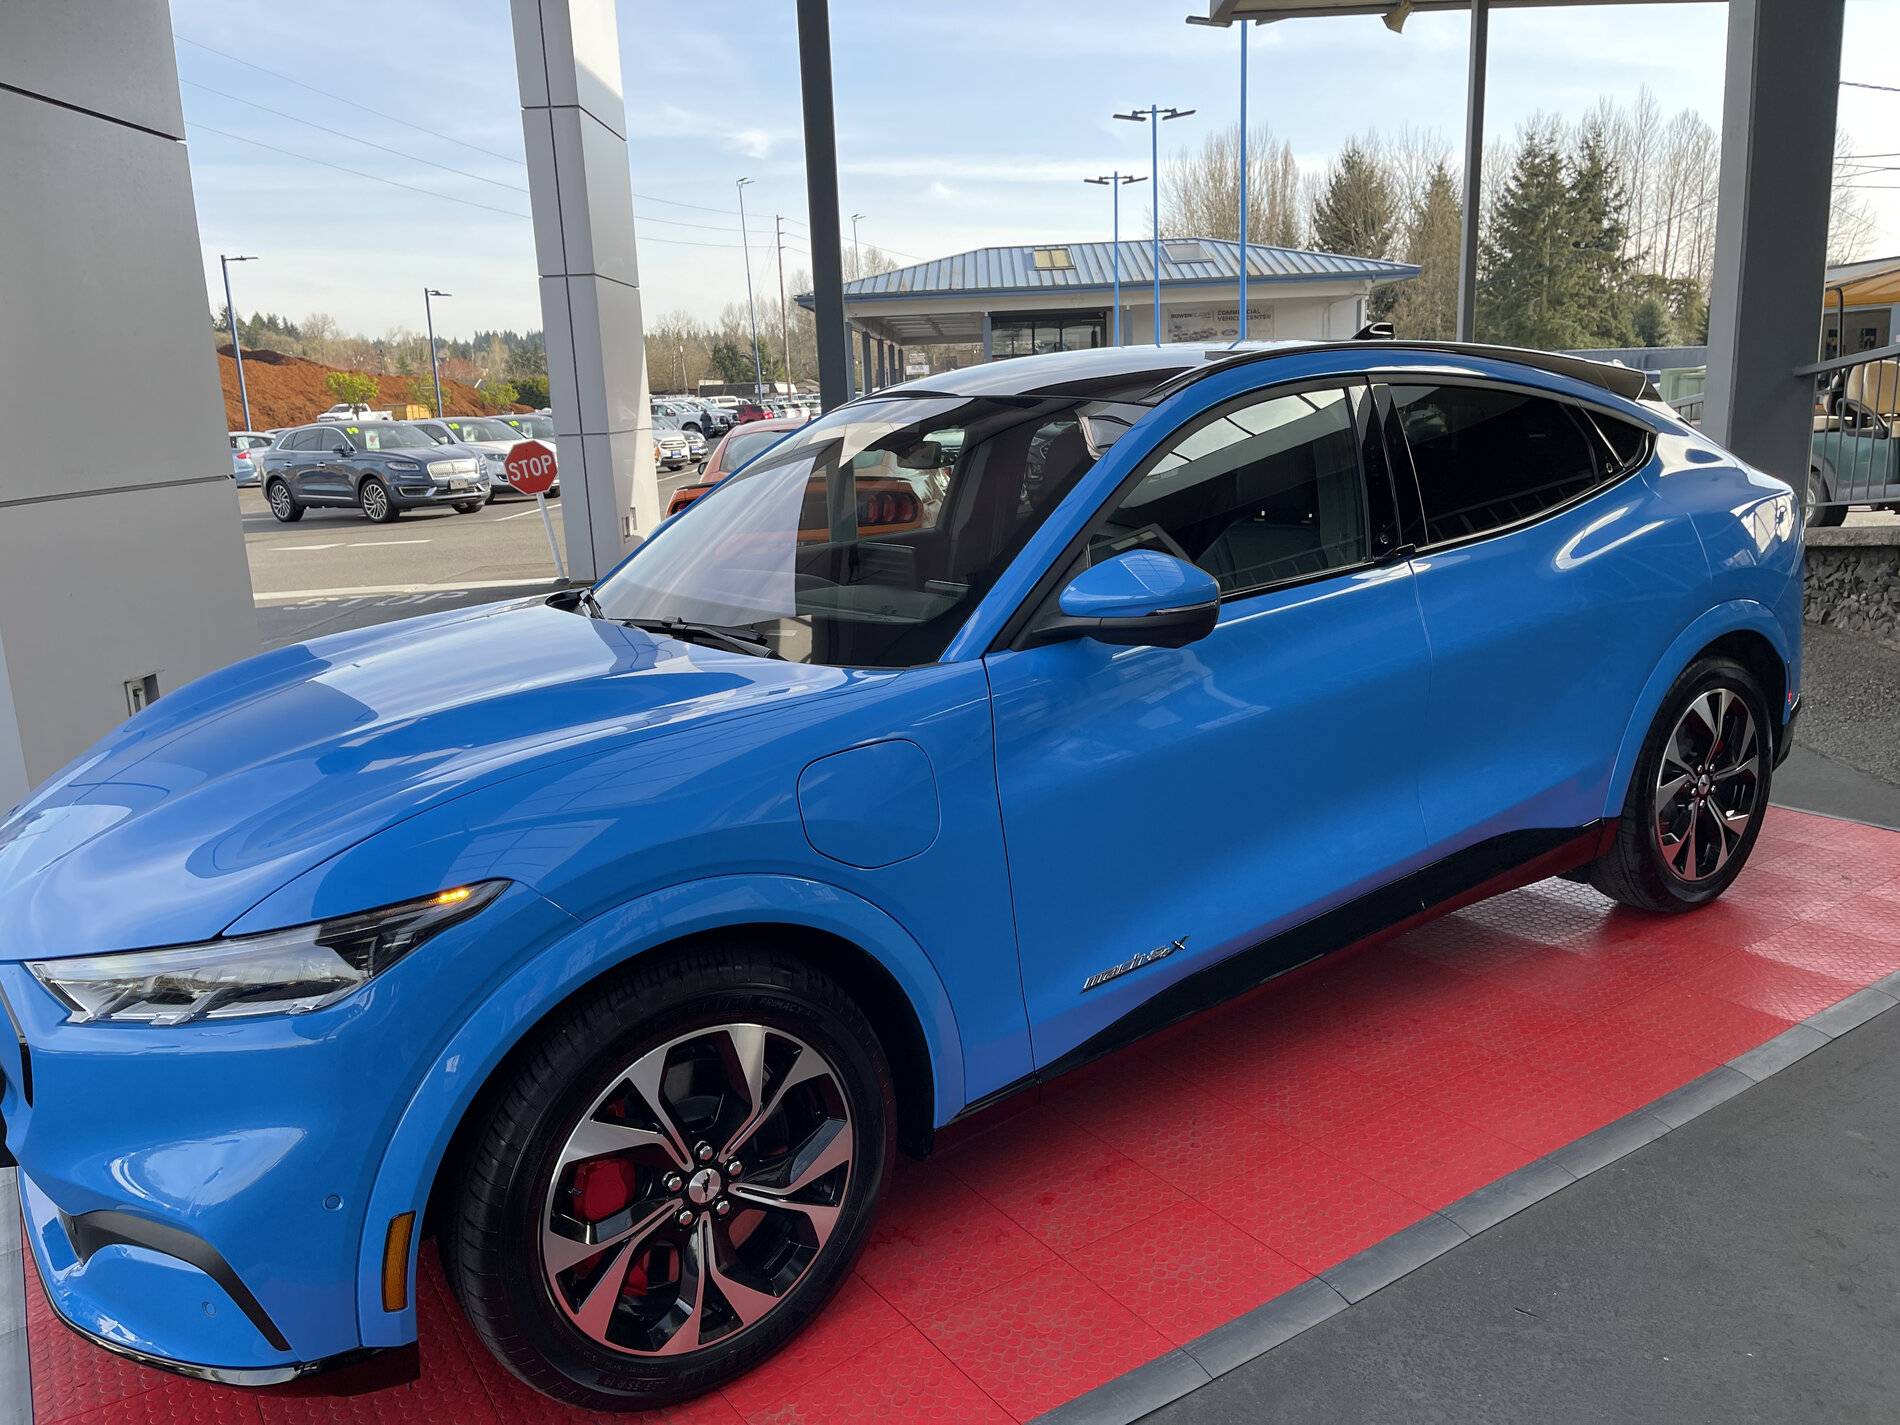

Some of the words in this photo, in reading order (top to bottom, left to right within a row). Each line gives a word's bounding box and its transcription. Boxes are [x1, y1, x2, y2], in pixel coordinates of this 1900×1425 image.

[1217, 308, 1260, 316] COMMECIAL
[508, 454, 552, 481] STOP
[283, 591, 469, 610] STOP
